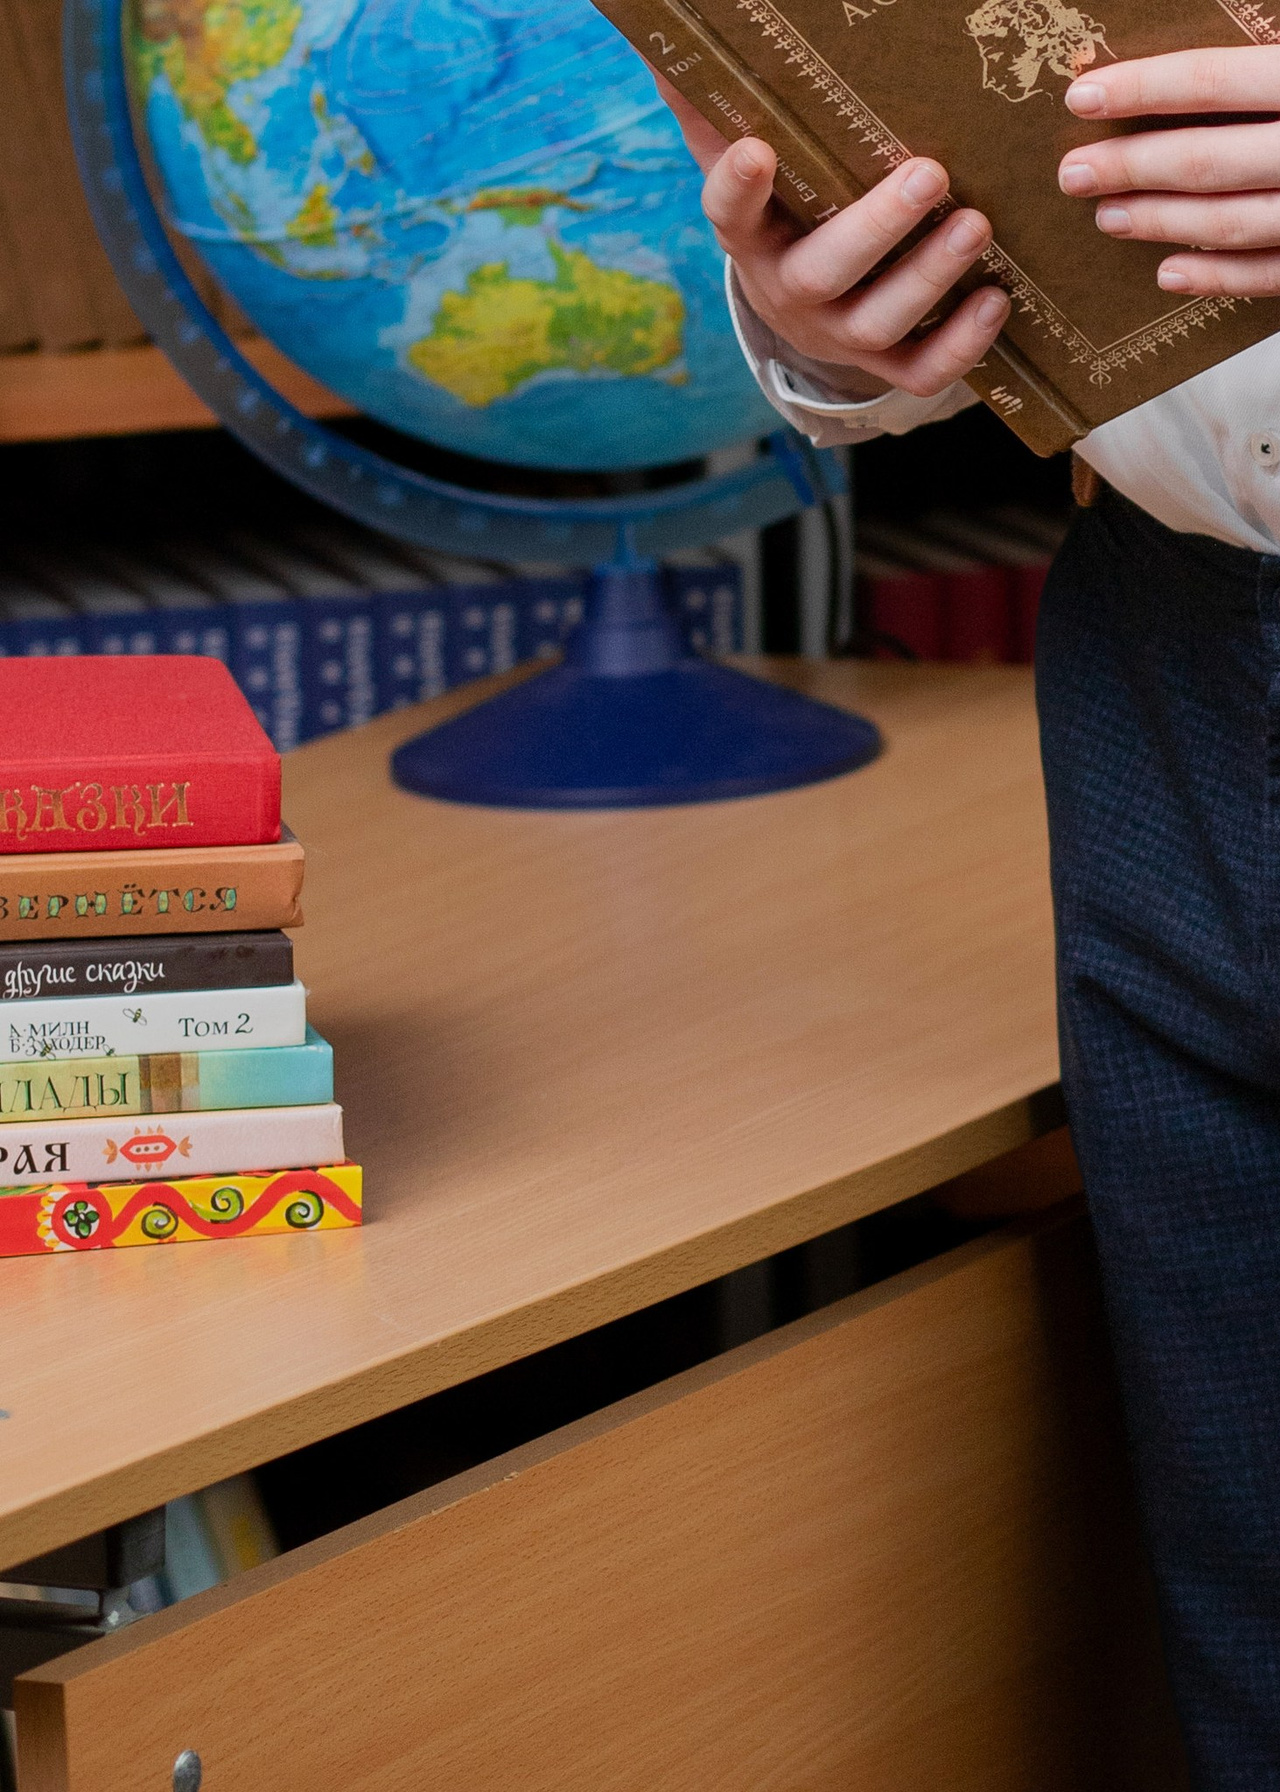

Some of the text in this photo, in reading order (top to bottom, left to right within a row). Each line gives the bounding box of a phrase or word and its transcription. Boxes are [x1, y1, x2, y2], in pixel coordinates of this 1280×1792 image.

[649, 31, 676, 55] 2
[775, 154, 819, 203] Евген
[3, 960, 166, 1000] другие сказки
[178, 1012, 254, 1037] Том 2
[0, 1071, 130, 1113] ЛАДЫ
